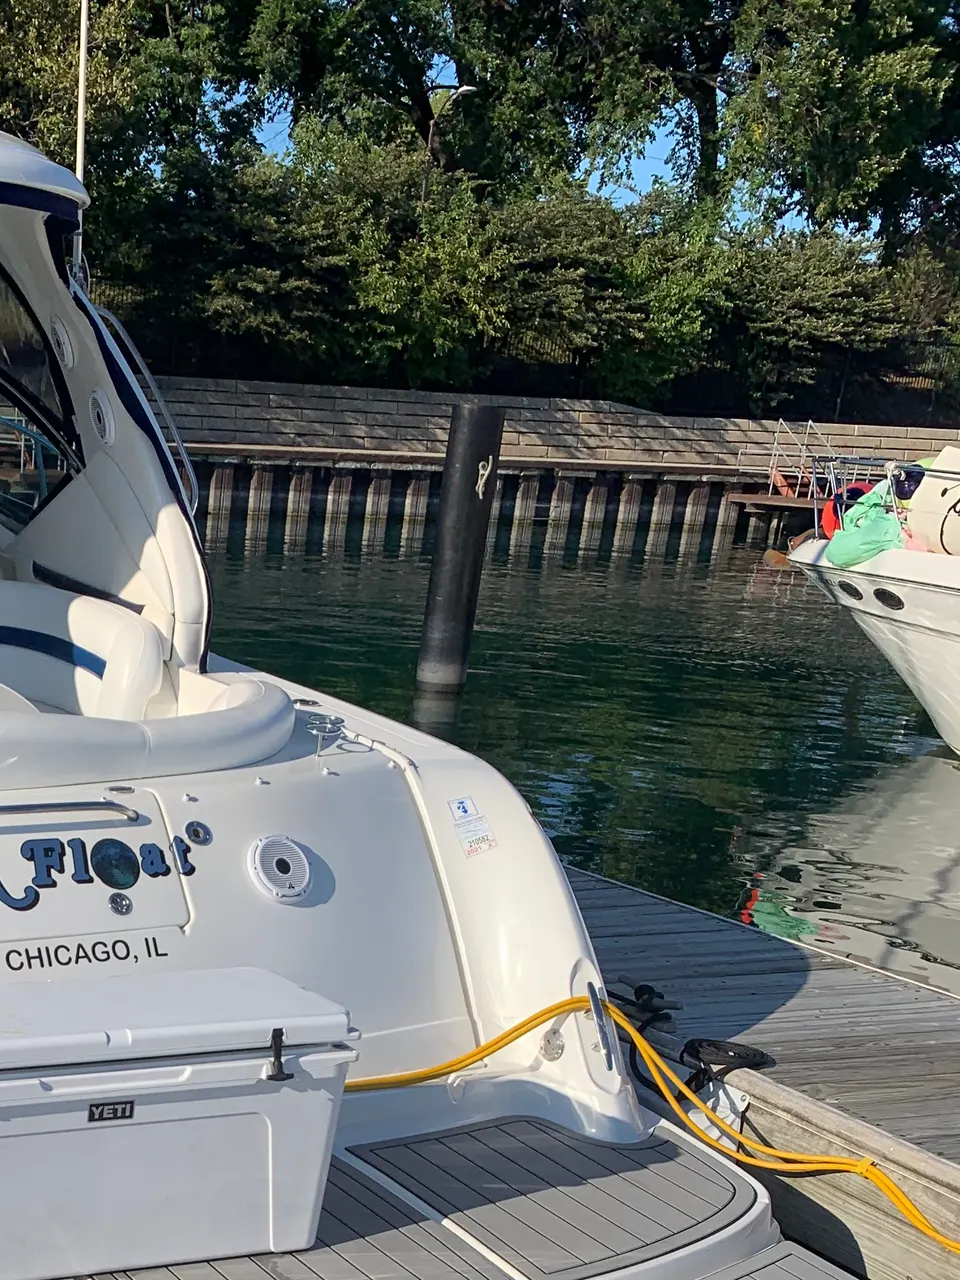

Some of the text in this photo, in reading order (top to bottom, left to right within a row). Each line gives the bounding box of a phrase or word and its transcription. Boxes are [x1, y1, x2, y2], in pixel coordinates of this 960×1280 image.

[5, 936, 169, 971] CHICAGO, IL
[90, 1103, 133, 1119] YETI
